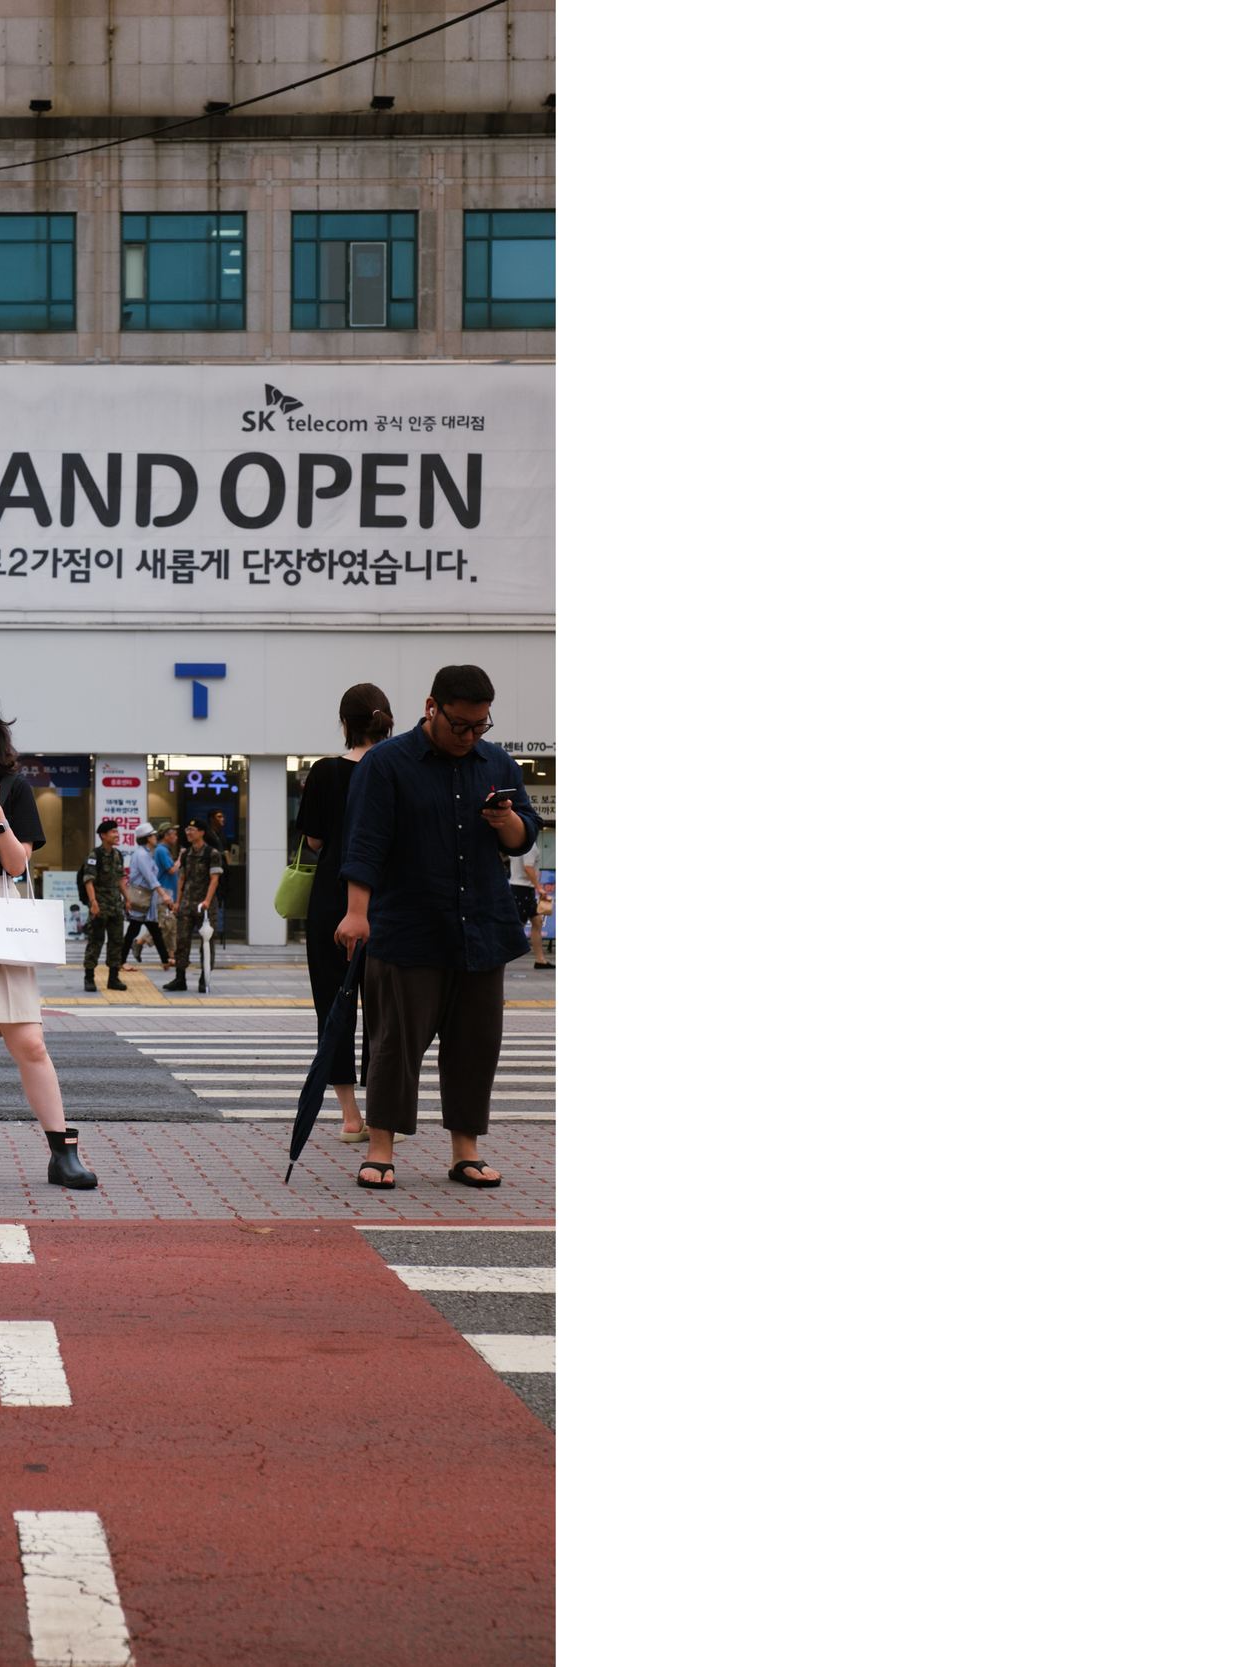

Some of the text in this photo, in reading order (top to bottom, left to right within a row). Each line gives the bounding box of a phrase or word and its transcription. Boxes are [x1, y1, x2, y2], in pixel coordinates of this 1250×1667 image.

[241, 410, 485, 432] SK telecom 공식 인증 대리점
[220, 451, 483, 529] OPEN
[136, 546, 230, 583] 새롭게
[241, 546, 478, 585] 단장하였습니다.
[174, 662, 227, 719] T
